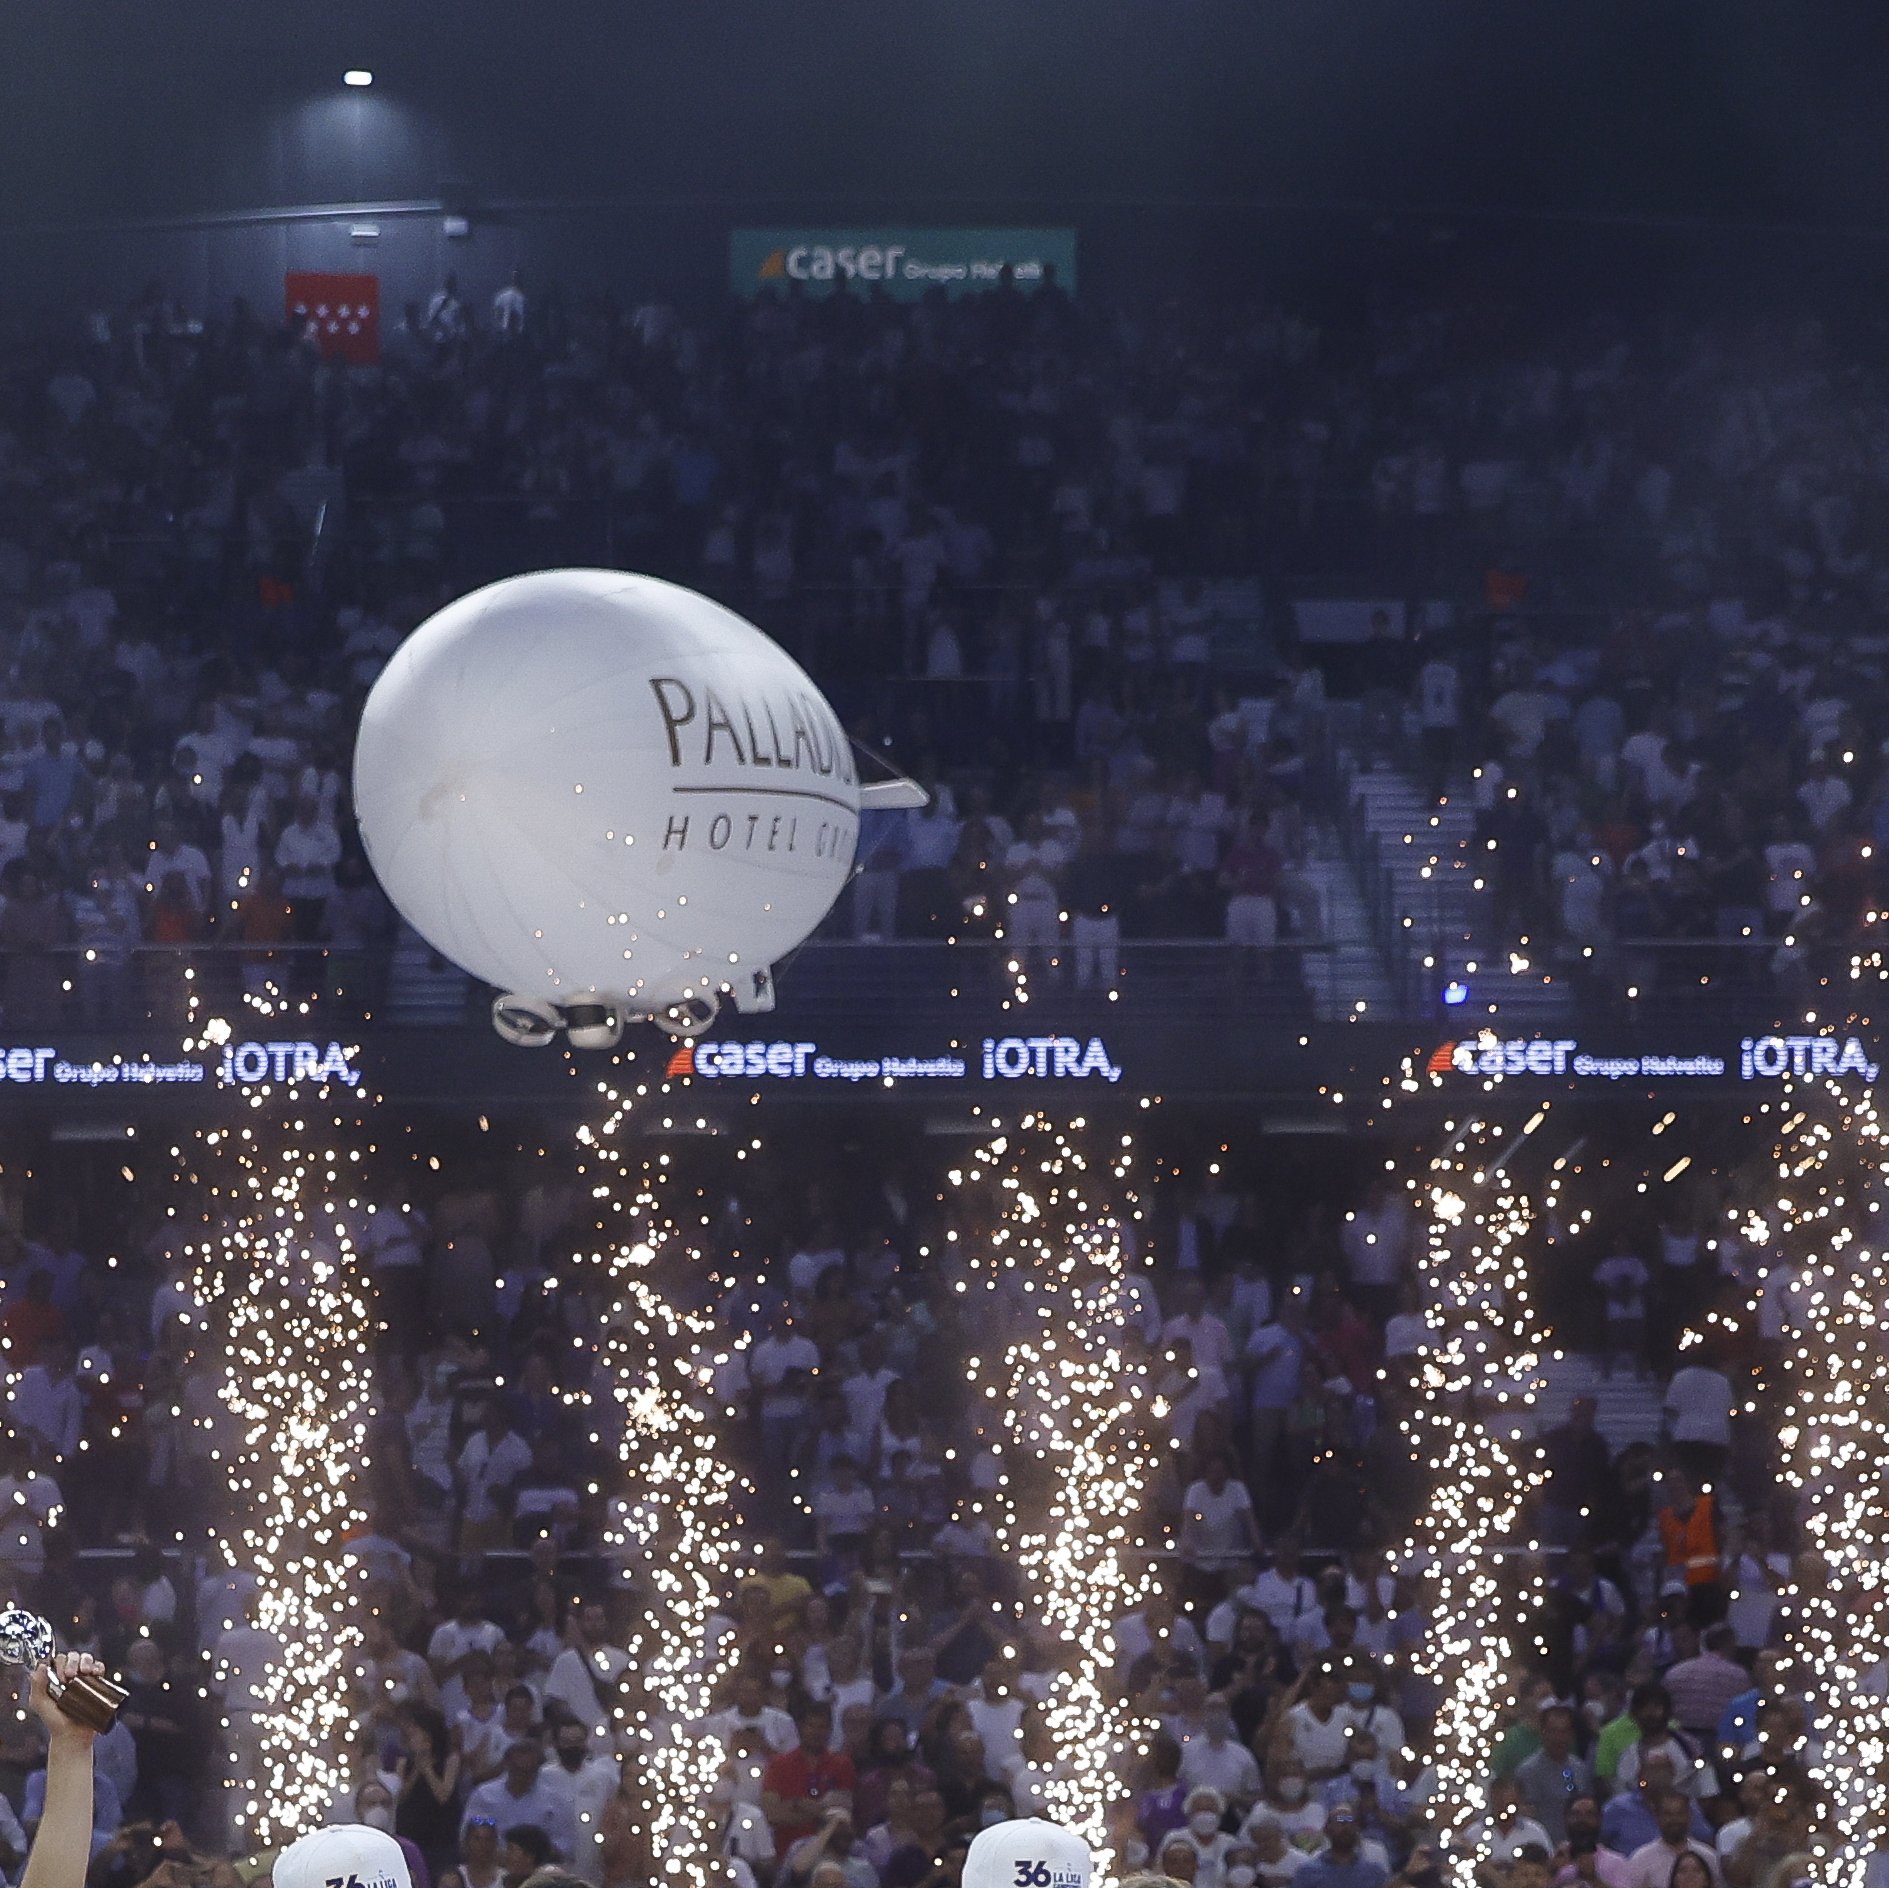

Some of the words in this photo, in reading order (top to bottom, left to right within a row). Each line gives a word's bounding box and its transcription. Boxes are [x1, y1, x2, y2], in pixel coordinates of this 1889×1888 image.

[788, 244, 905, 281] caser
[662, 813, 798, 853] HOTEL
[693, 1040, 816, 1078] caser
[1455, 1039, 1577, 1075] caser
[1014, 1860, 1052, 1888] 36
[1053, 1872, 1065, 1883] LA
[1066, 1872, 1082, 1885] LIGA
